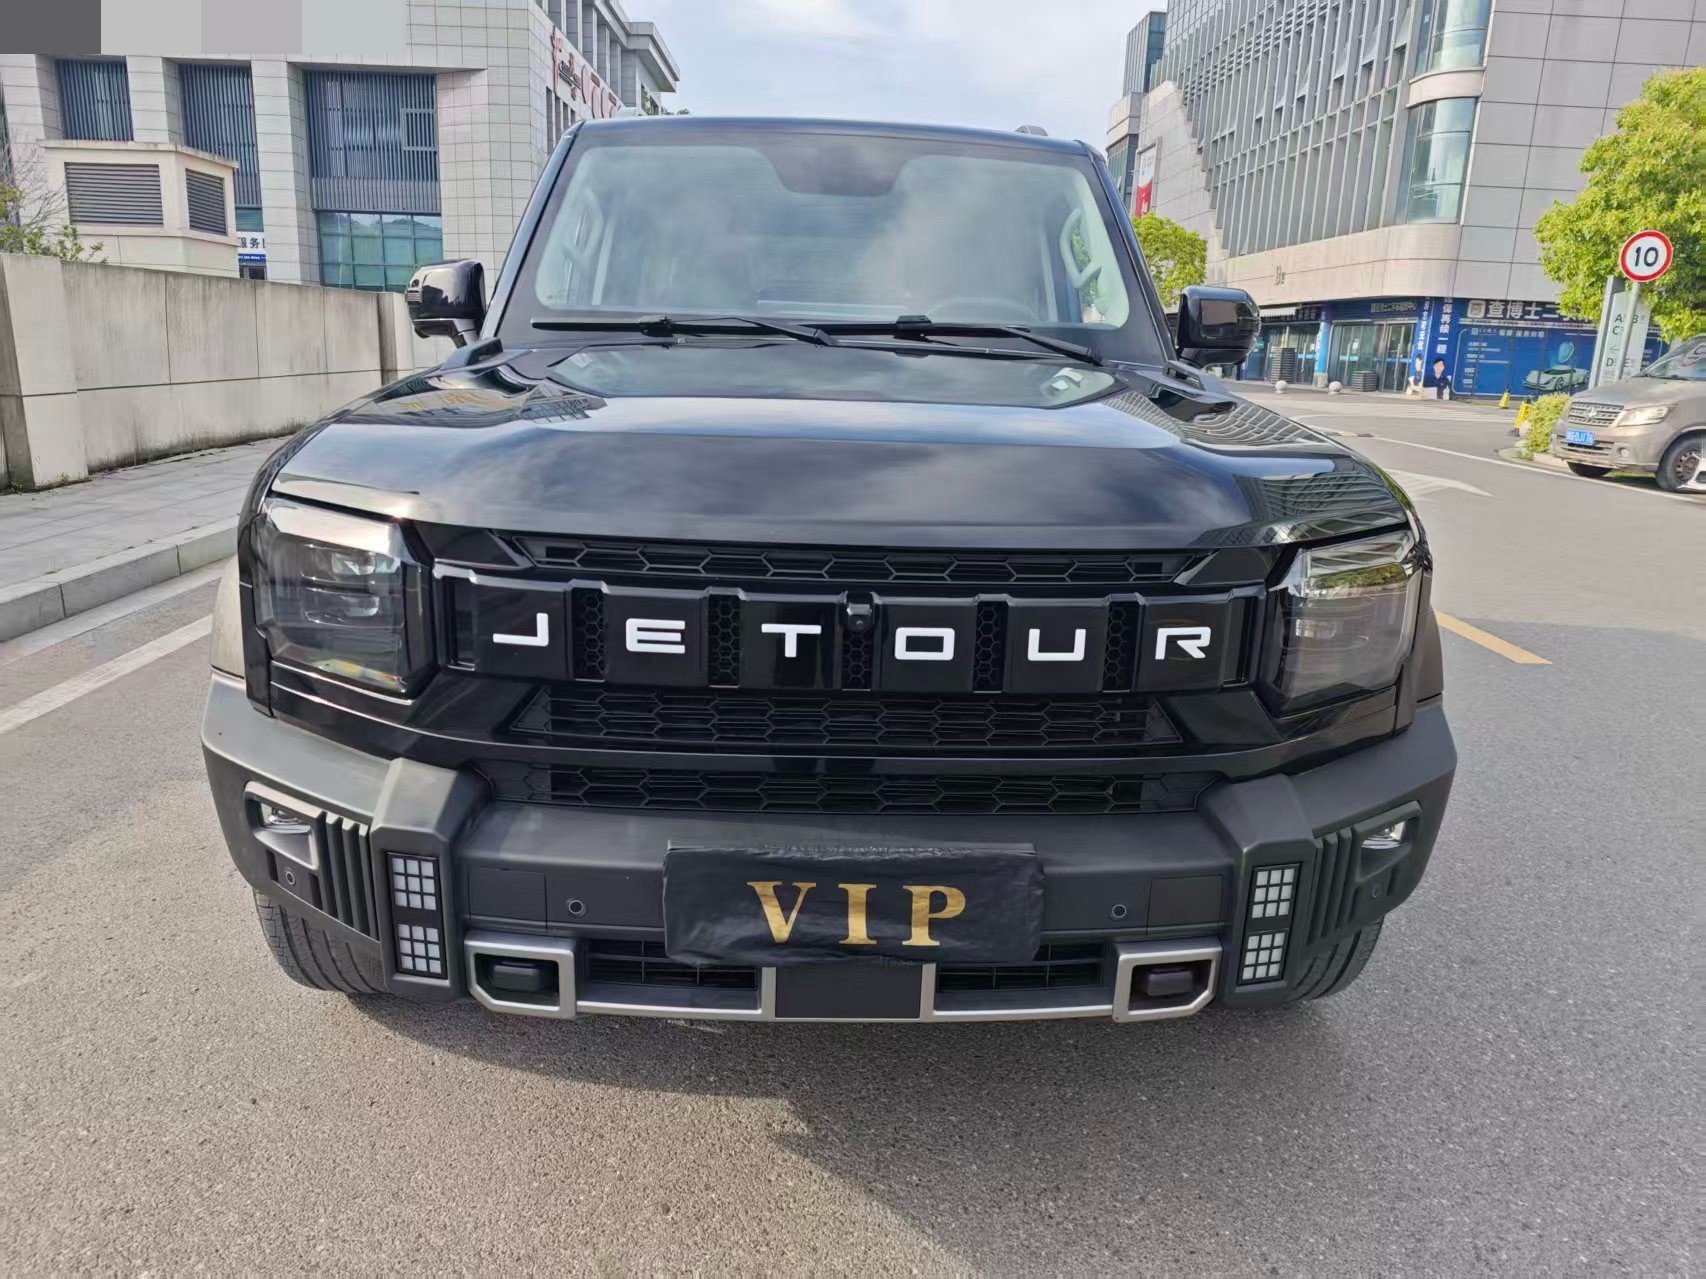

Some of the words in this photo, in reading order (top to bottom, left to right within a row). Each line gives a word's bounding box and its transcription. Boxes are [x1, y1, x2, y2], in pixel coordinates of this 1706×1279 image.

[240, 237, 266, 249] 服务
[1634, 246, 1659, 268] 10
[1486, 299, 1592, 323] 查博士二
[493, 611, 1211, 662] JETOUR
[747, 881, 966, 947] VIP
